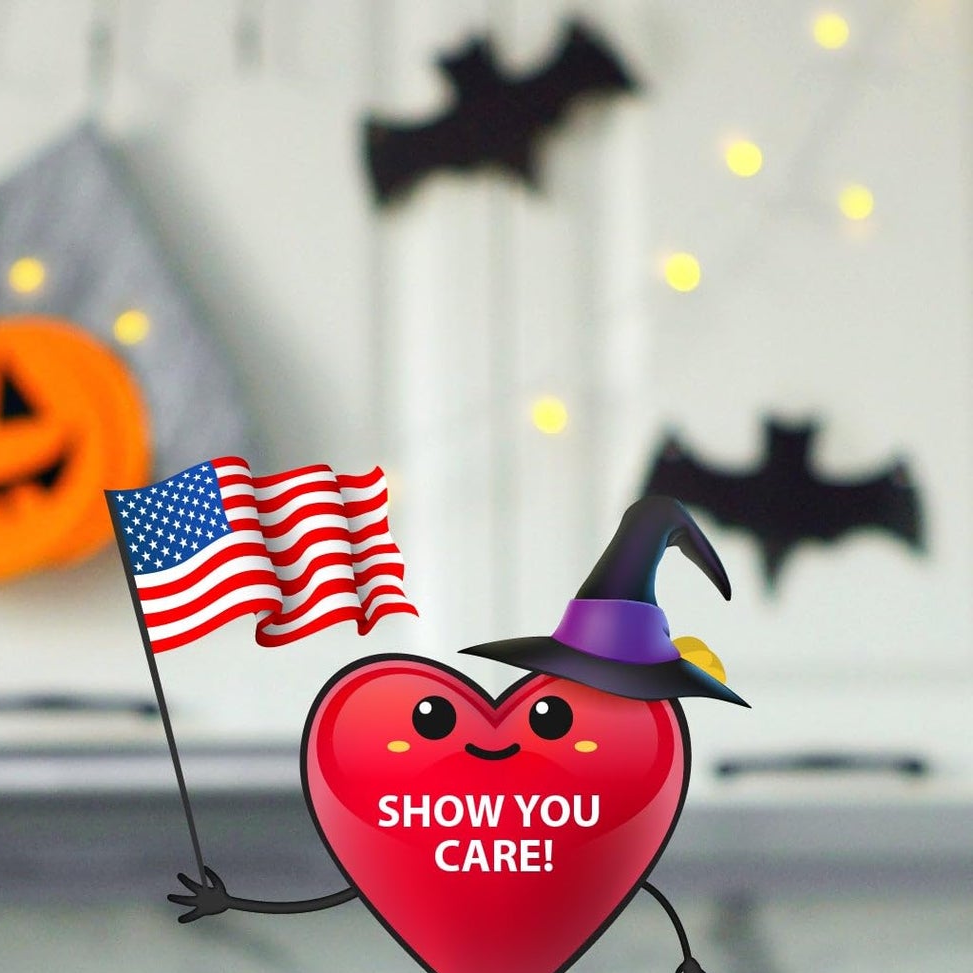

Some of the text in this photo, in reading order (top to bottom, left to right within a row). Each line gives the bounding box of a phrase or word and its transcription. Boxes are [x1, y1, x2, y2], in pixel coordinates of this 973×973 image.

[378, 794, 600, 828] SHOW YOU
[435, 840, 553, 872] CARE!
